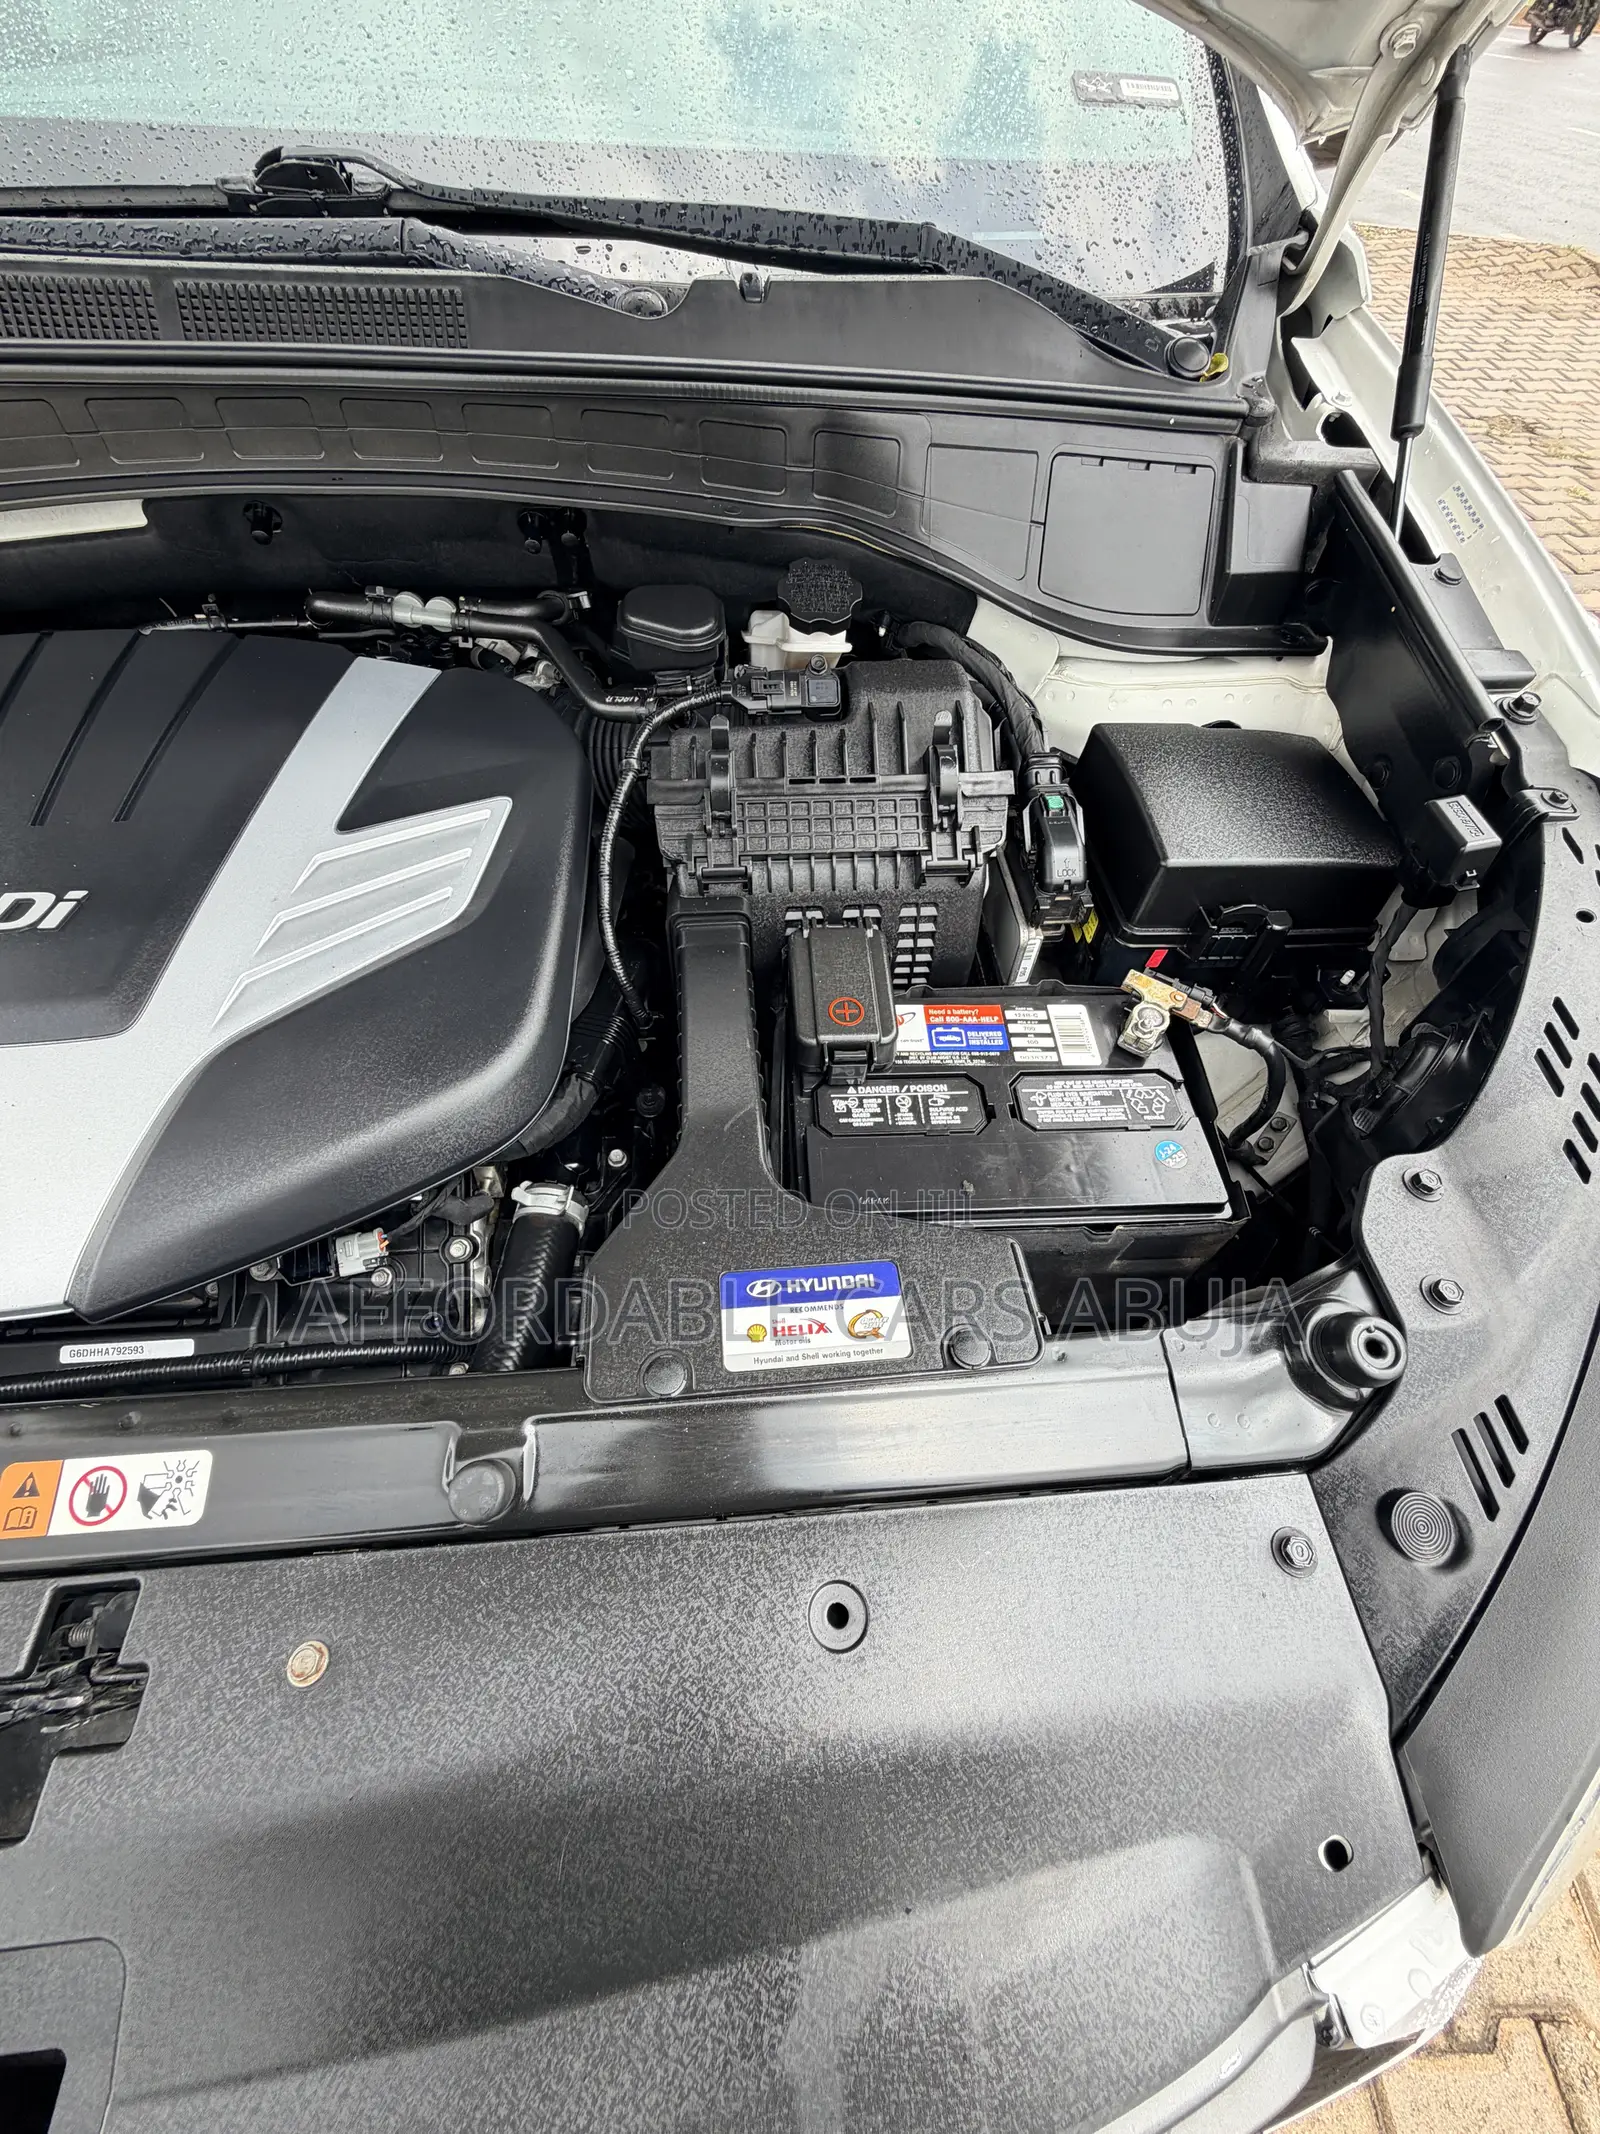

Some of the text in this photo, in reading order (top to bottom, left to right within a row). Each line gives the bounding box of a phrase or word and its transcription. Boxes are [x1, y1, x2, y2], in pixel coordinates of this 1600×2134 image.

[1057, 868, 1077, 877] LOCK
[953, 1009, 979, 1017] battery?
[857, 1085, 900, 1093] DANGER
[910, 1084, 948, 1092] POISON
[787, 1273, 875, 1293] HYUNDAI
[790, 1303, 844, 1314] RECOMMENDS
[773, 1322, 832, 1338] HELIX
[798, 1337, 811, 1345] oils
[69, 1346, 144, 1358] G6DHHA792593
[753, 1347, 884, 1365] Hyundai and Shell working together
